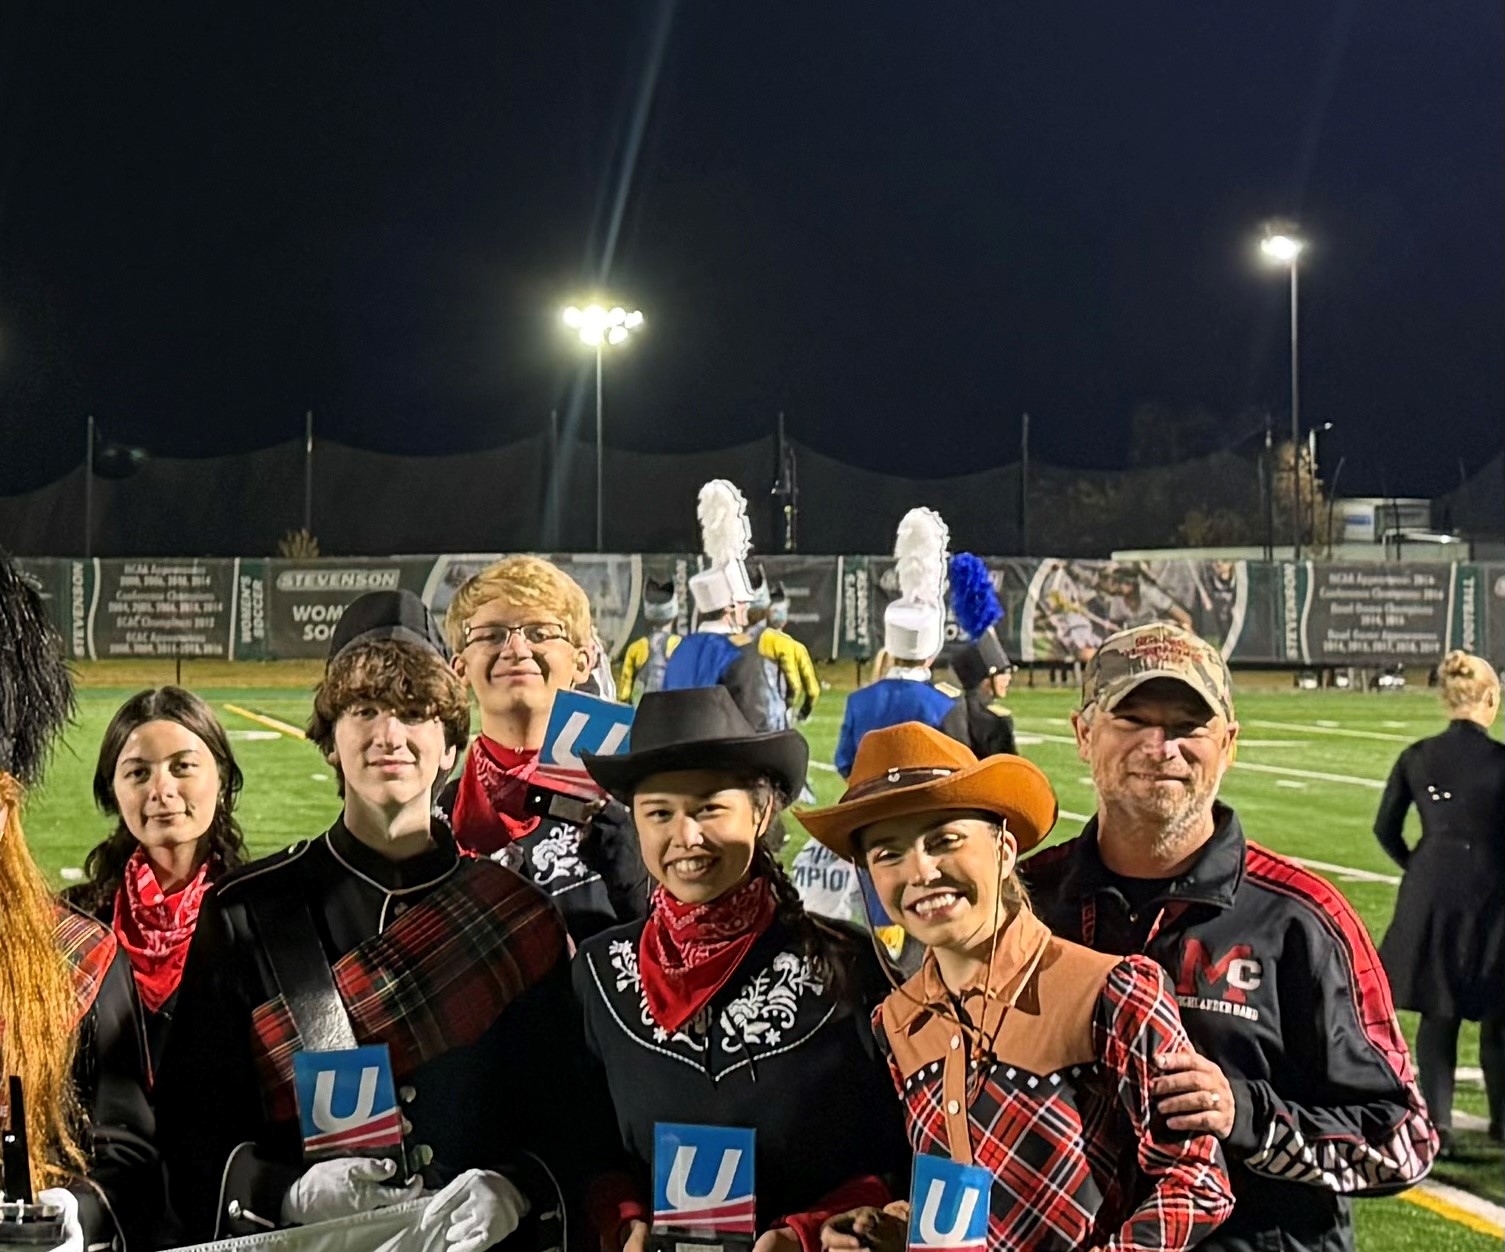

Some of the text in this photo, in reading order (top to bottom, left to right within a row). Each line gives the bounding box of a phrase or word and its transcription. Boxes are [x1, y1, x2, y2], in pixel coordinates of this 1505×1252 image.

[72, 561, 85, 657] STEVENSON
[240, 576, 252, 643] WOMEN'S
[252, 579, 264, 639] SOCCER
[281, 573, 396, 587] STEVENSON
[293, 604, 348, 622] WOM
[1284, 563, 1298, 659] STEVENSON
[1462, 576, 1476, 653] FOOTBALL
[1232, 1003, 1259, 1021] BAND
[312, 1066, 379, 1133] U
[665, 1147, 742, 1210] U
[918, 1179, 981, 1246] U
